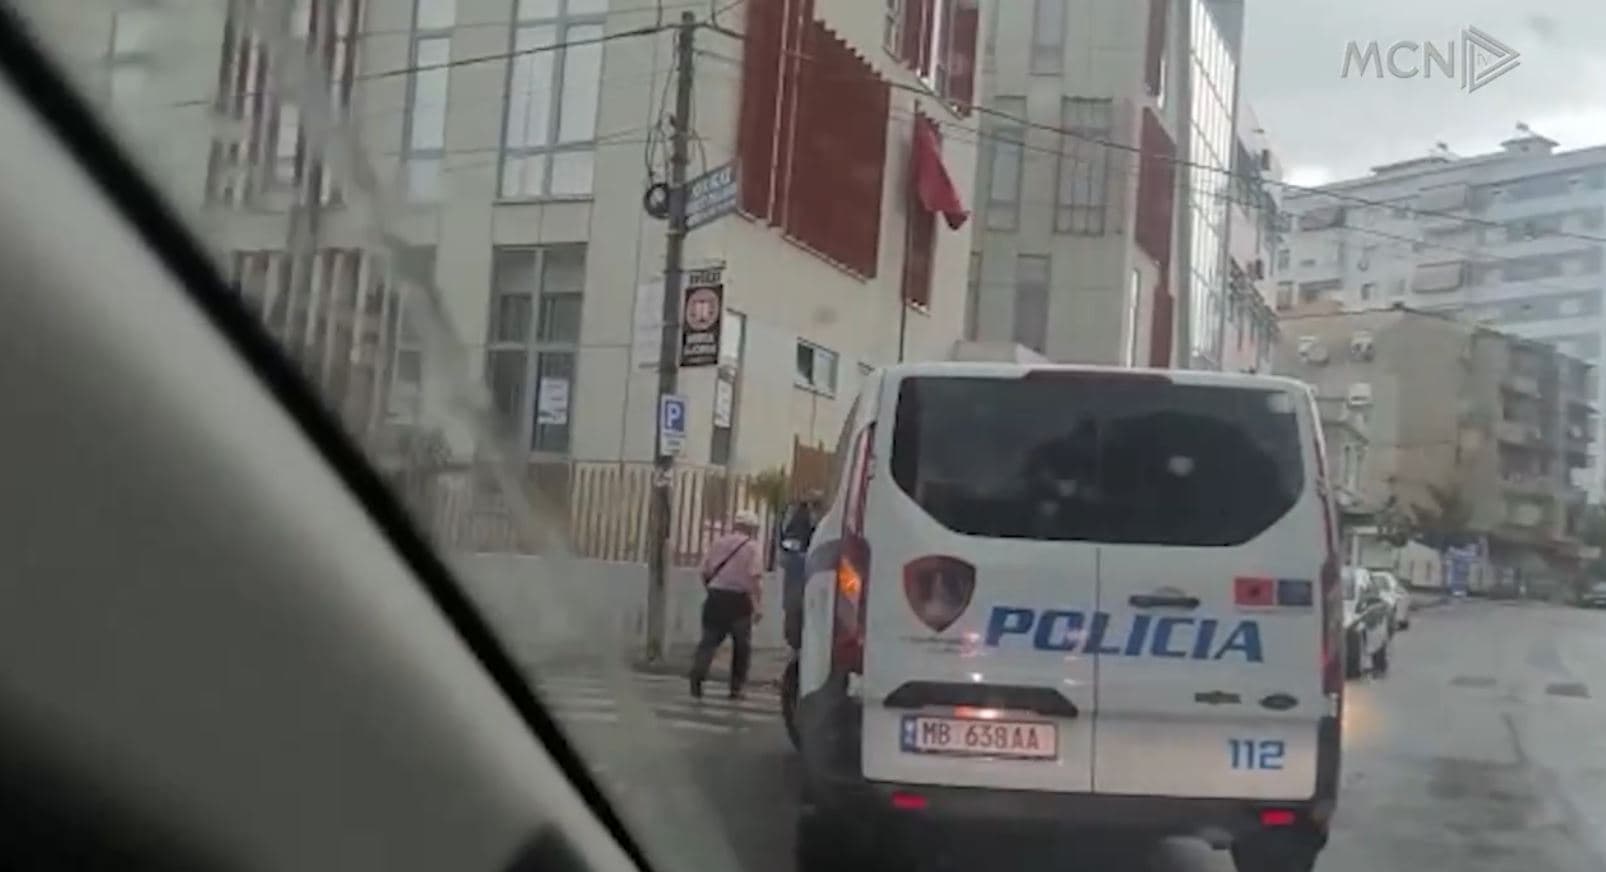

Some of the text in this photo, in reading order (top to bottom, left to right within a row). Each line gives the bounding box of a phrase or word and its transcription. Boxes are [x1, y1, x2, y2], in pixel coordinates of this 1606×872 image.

[667, 402, 681, 428] P
[984, 605, 1265, 664] POLICIA
[921, 721, 951, 746] MB
[1227, 738, 1286, 771] 112
